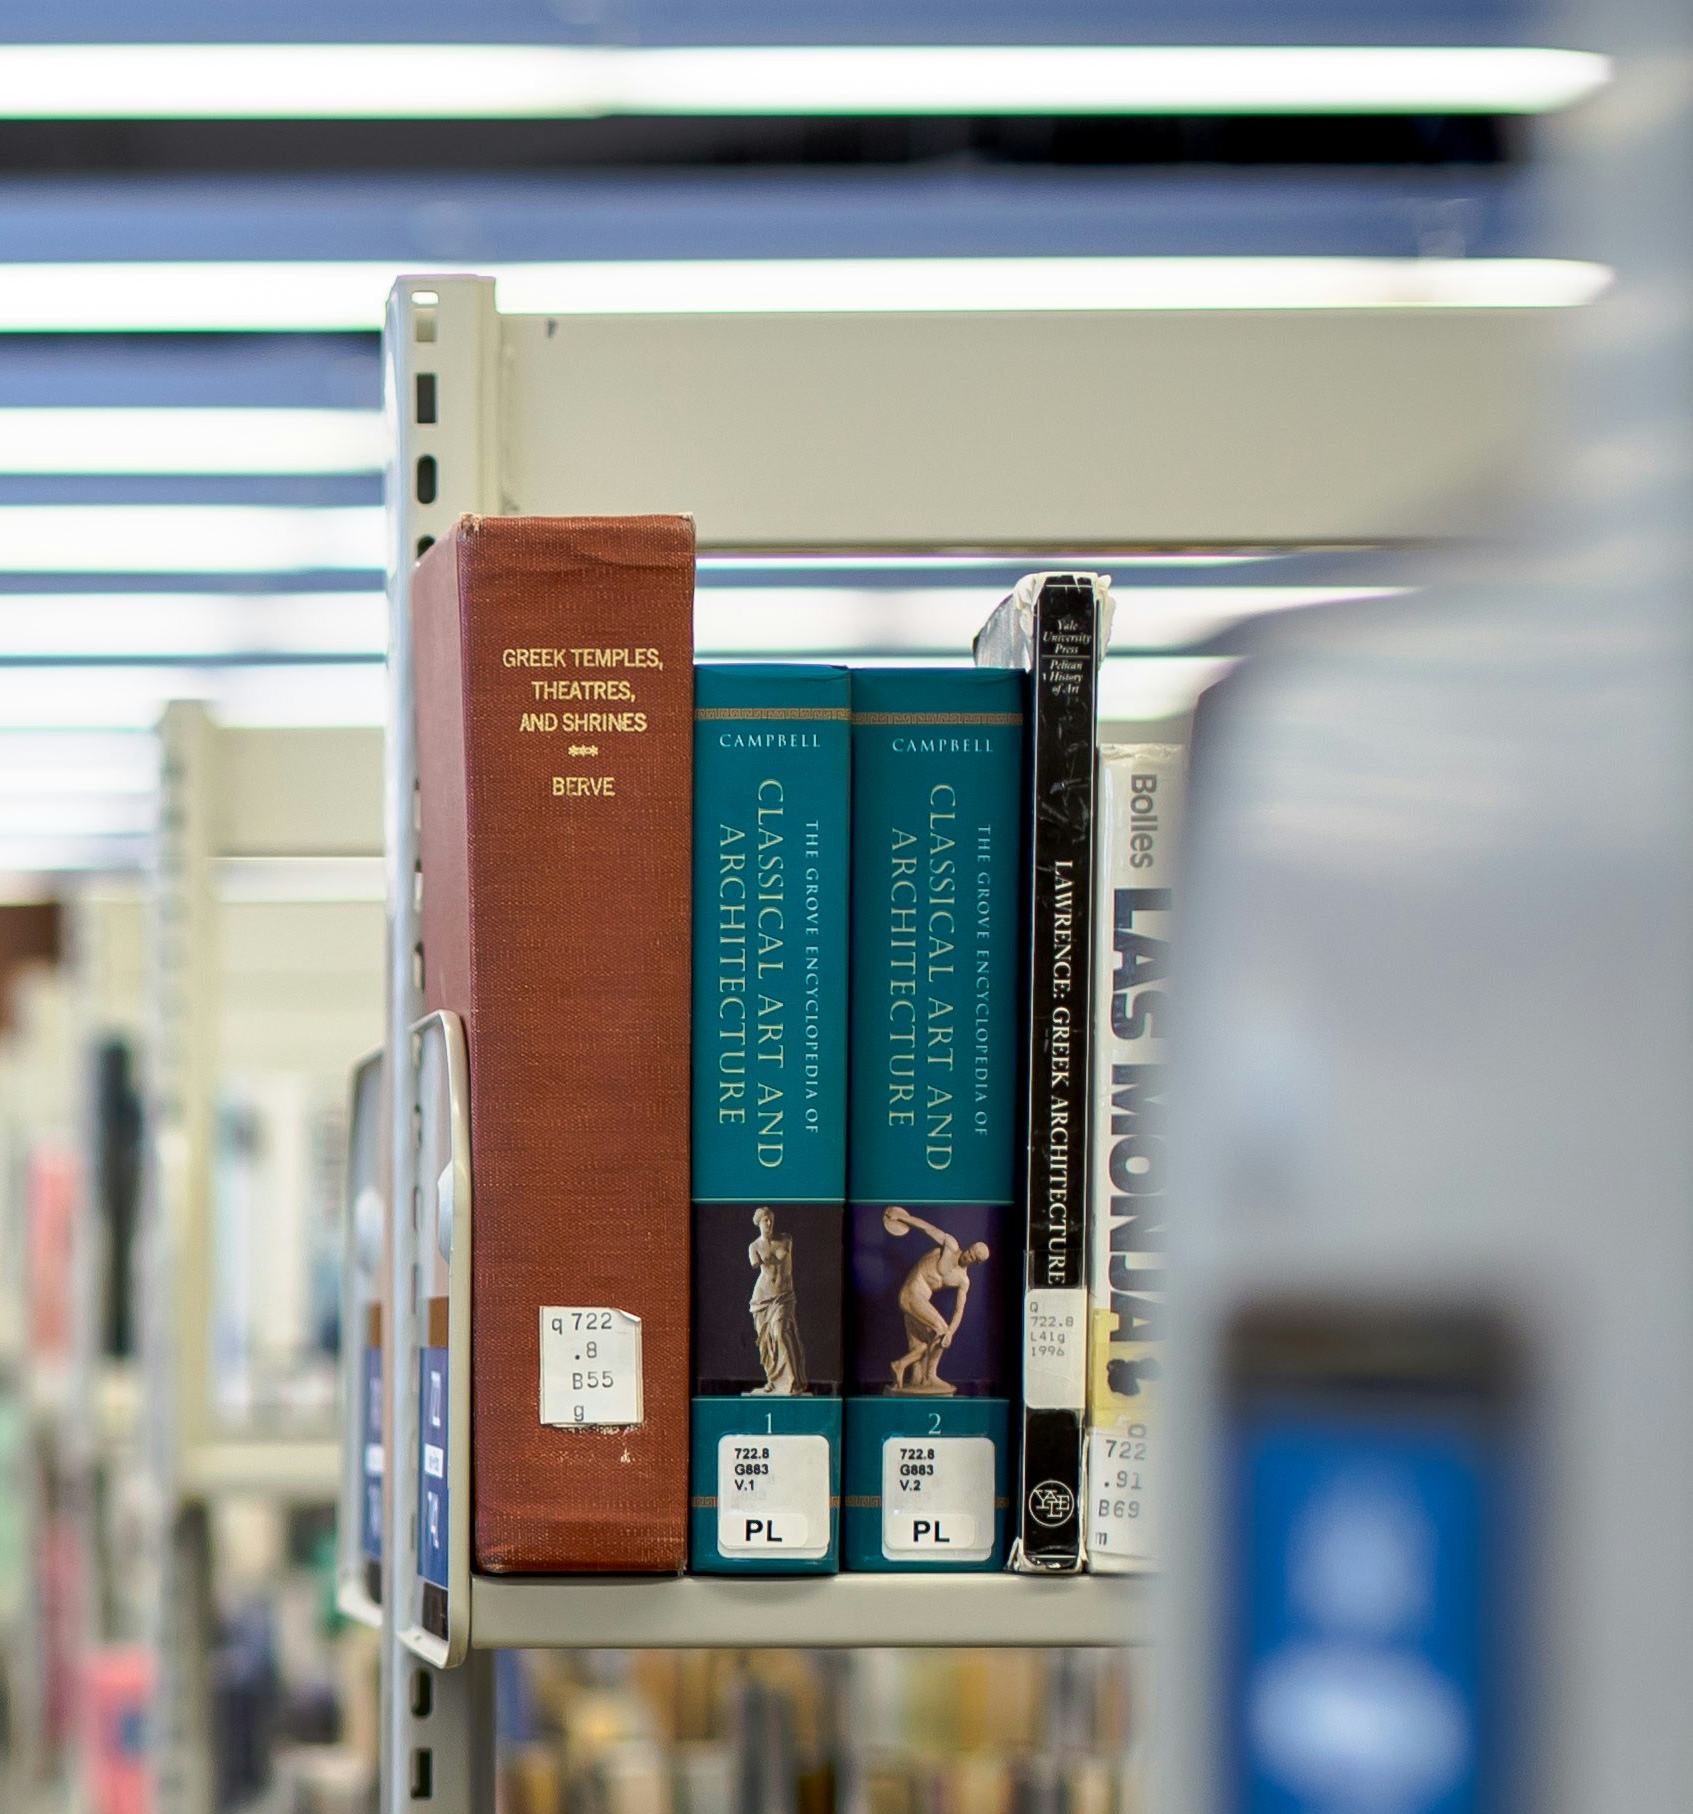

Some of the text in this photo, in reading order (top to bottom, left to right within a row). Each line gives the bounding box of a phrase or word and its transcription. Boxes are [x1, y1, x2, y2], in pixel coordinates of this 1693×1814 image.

[1057, 620, 1078, 630] Yale
[1043, 632, 1092, 644] University
[1055, 644, 1079, 654] Press
[503, 649, 663, 671] GREEK TEMPLES,
[1050, 660, 1083, 670] Pelican
[1049, 671, 1083, 684] History
[532, 681, 636, 703] THEATRES,
[1052, 683, 1080, 695] of Art
[520, 713, 647, 732] AND SHRINES
[720, 733, 821, 748] CAMPBELL
[892, 738, 994, 752] CAMPBELL
[552, 777, 615, 797] BERVE
[1130, 774, 1158, 868] Bolles
[1112, 888, 1173, 1040] LAS
[720, 824, 745, 1125] ARCHITECTURE
[758, 780, 783, 1168] CLASSICAL ART AND
[806, 820, 819, 1133] THE GROVE ENCYCLOPEDIA OF
[888, 829, 917, 1126] ARCHITECTURE
[926, 785, 956, 1170] CLASSICAL ART AND
[974, 825, 991, 1136] THE GROVE ENCYCLOPEDIA OF
[1047, 860, 1073, 1284] LAWRENCE: GREEK ARCHITECTURE
[571, 1313, 613, 1331] 722
[1031, 1316, 1074, 1328] 722.8
[1031, 1346, 1065, 1357] 1996
[572, 1371, 614, 1390] B55
[734, 1448, 769, 1460] 722.8
[900, 1449, 934, 1460] 722.8
[1105, 1440, 1146, 1459] 722
[734, 1464, 769, 1476] G883
[900, 1465, 934, 1476] G883
[734, 1480, 755, 1491] V.1
[900, 1480, 921, 1492] V.2
[1099, 1499, 1140, 1518] B69
[745, 1520, 782, 1542] PL
[913, 1521, 950, 1543] PL
